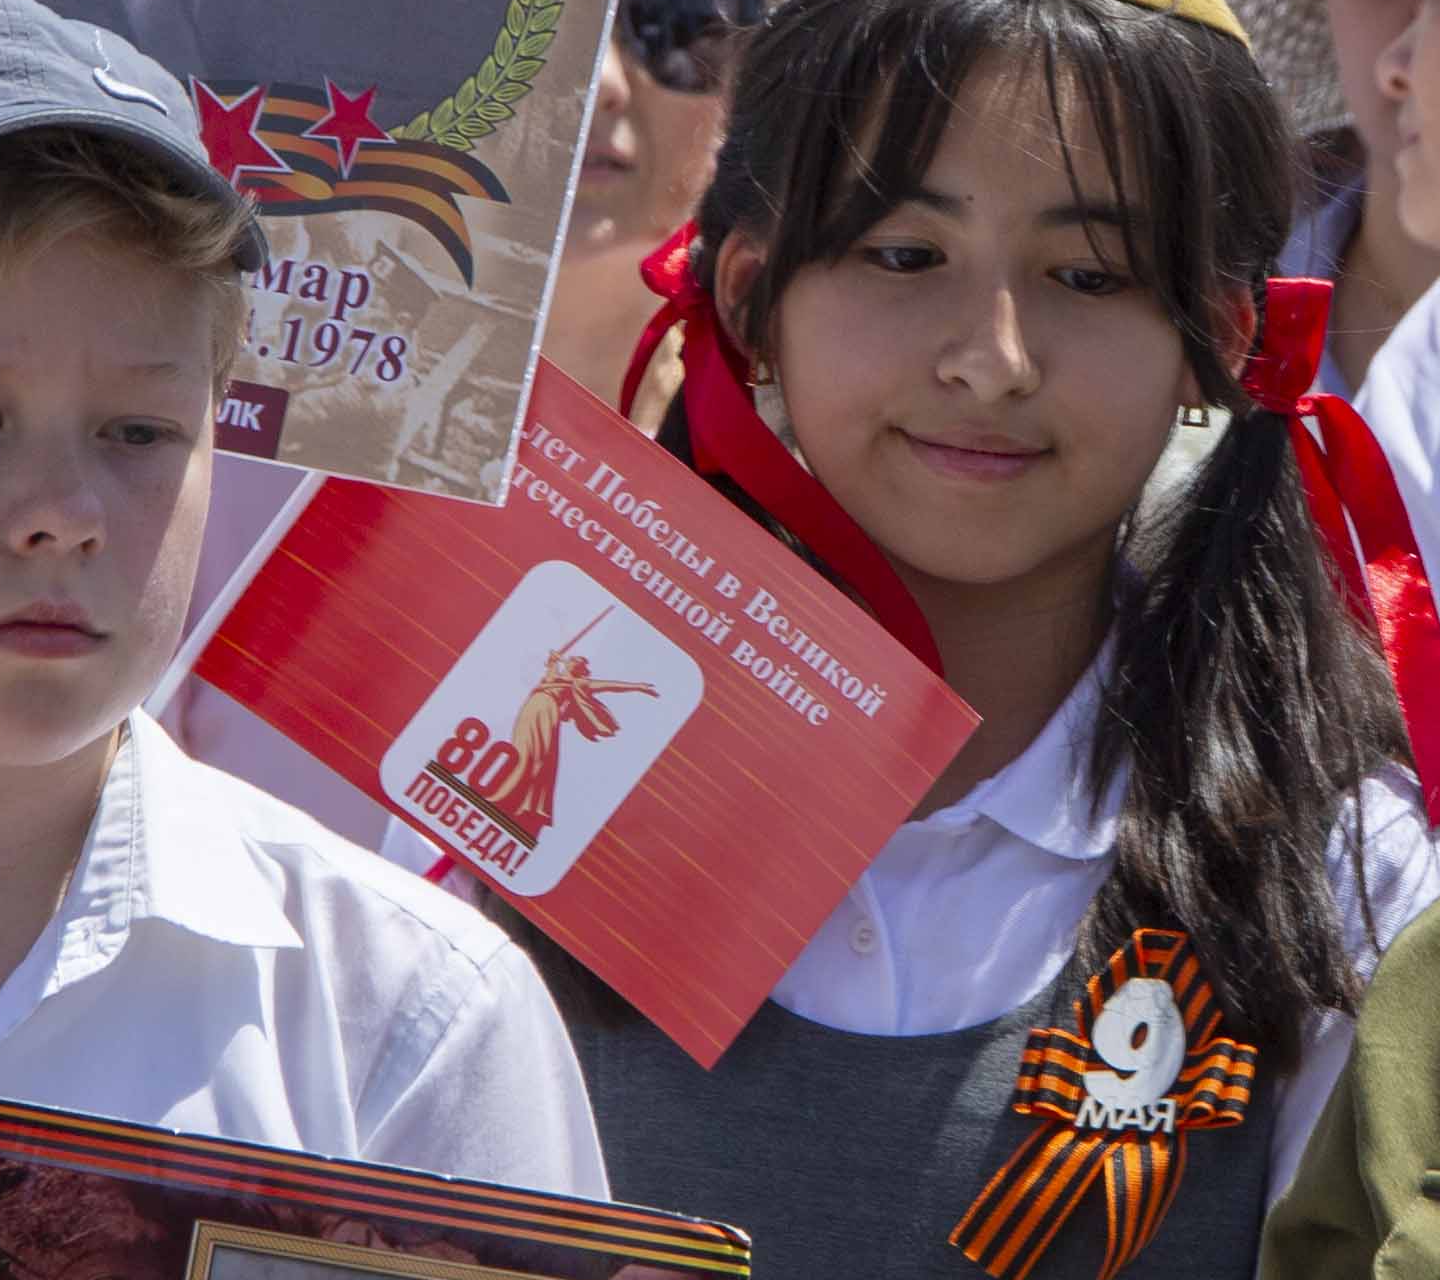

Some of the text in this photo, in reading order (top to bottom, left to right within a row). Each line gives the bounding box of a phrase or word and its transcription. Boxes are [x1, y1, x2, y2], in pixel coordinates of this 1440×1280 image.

[583, 460, 718, 579] Победы
[713, 569, 744, 601] в
[742, 585, 889, 721] Великой
[729, 637, 831, 728] войне
[437, 716, 520, 800] 80
[403, 770, 530, 878] ПОБЕДА!
[1083, 977, 1186, 1107] 9
[1074, 1095, 1177, 1134] МАЯ
